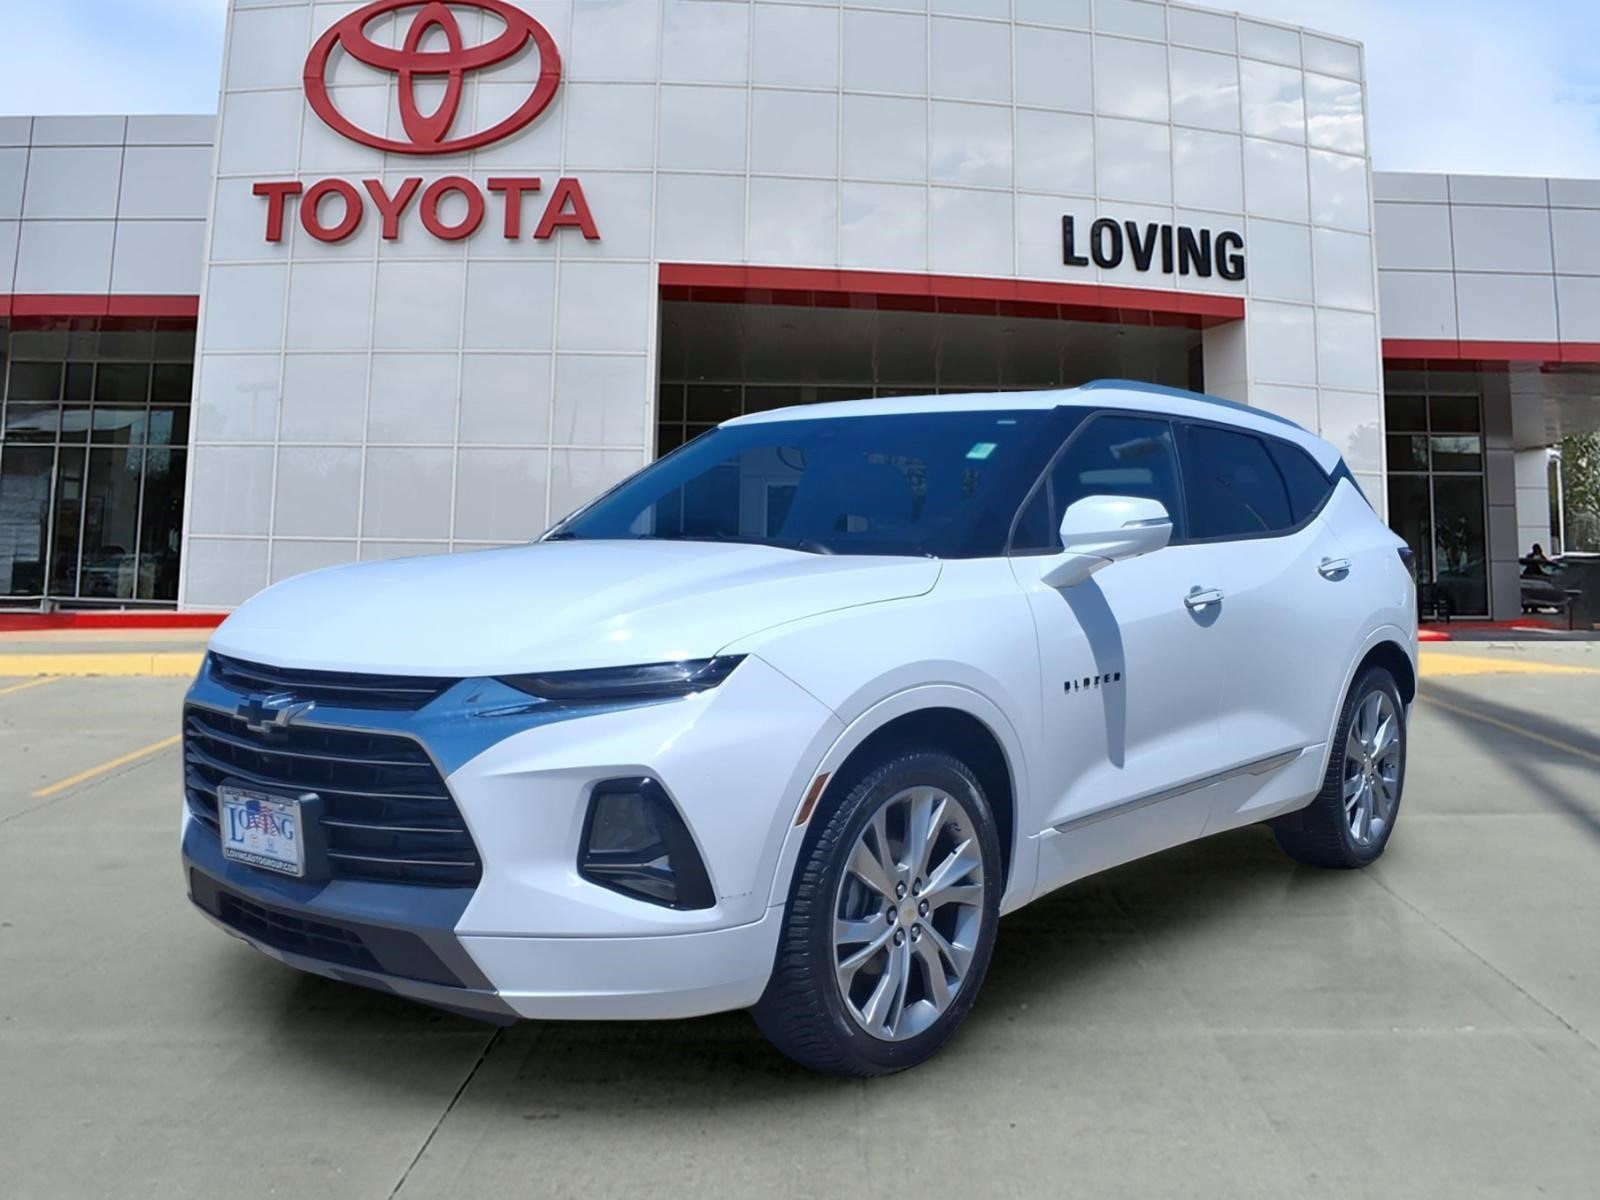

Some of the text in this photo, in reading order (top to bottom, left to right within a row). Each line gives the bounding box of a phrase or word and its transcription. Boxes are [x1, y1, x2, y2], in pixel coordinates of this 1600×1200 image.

[253, 176, 601, 243] TOYOTA
[1062, 214, 1246, 281] LOVING
[228, 807, 294, 844] LOVING
